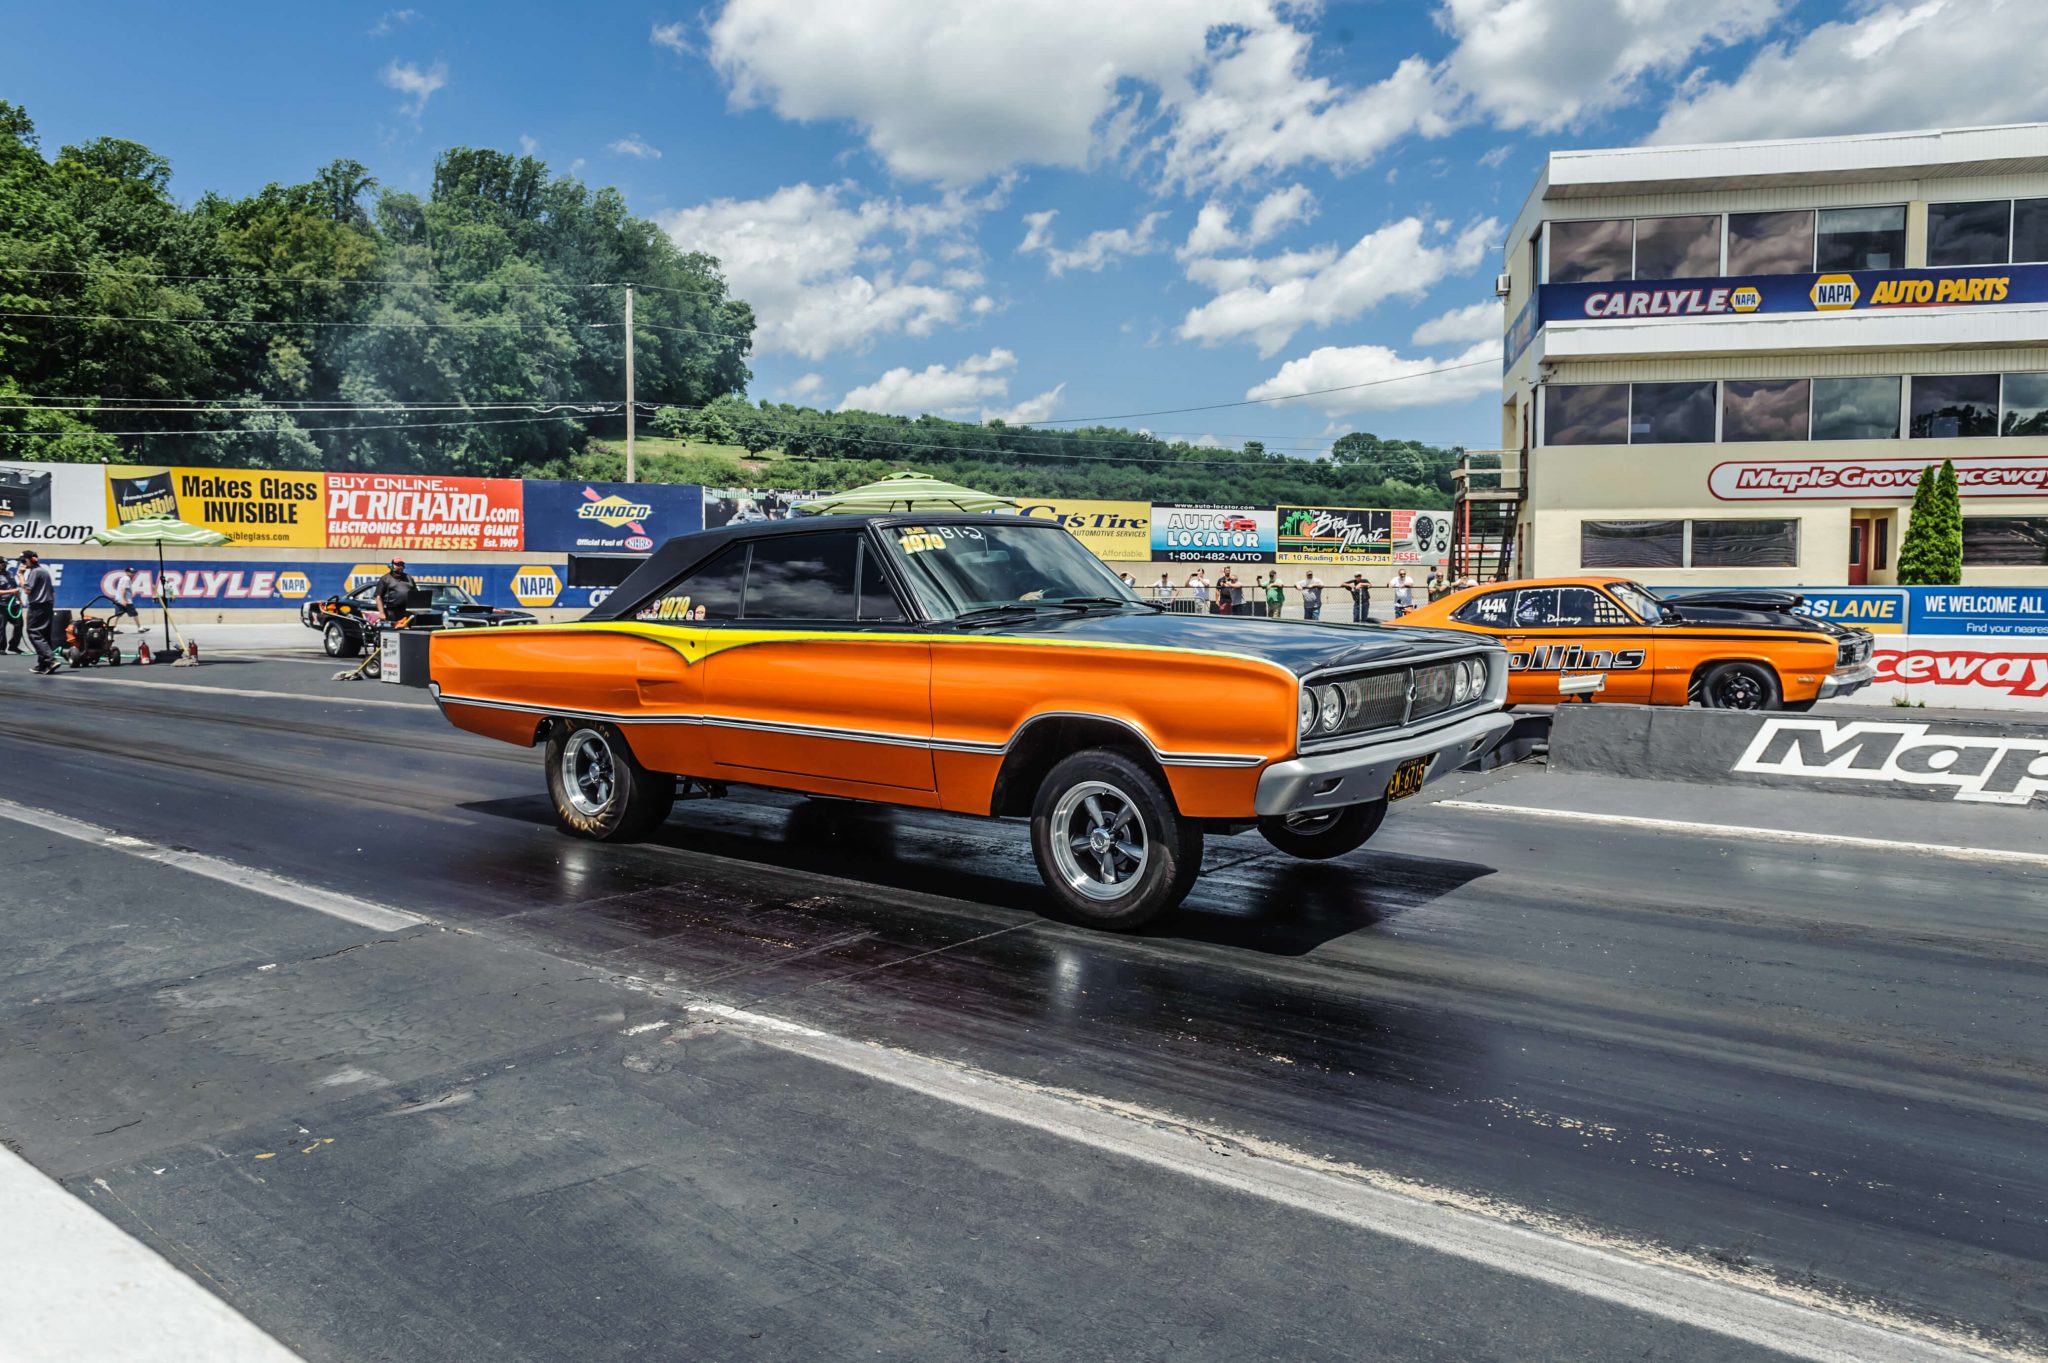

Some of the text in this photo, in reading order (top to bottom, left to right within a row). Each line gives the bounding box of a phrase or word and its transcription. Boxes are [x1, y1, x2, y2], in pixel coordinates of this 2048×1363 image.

[1735, 293, 1756, 305] NAPA
[1818, 284, 1852, 303] NAPA
[1870, 278, 2010, 304] AUTO PARTS
[1584, 288, 1730, 317] CARLYLE
[328, 476, 459, 492] BUY ONLINE...
[1736, 466, 2048, 493] Maple Grove acewa
[182, 476, 252, 499] Makes
[260, 477, 317, 501] Glass
[118, 495, 175, 520] Invisible
[204, 501, 297, 524] INVISIBLE
[581, 505, 648, 518] SUNOCO
[328, 521, 519, 536] ELECTRONICS & APPLIANCE GIANT
[1090, 513, 1148, 529] Tire
[1168, 513, 1226, 530] AUTO
[1310, 510, 1361, 538] Beer
[1116, 530, 1147, 538] SERVICES
[1167, 531, 1259, 548] LOCATOR
[1338, 528, 1390, 553] Mart
[483, 538, 519, 548] Est. 1909
[576, 537, 649, 549] Official Fuel of NHRA
[898, 534, 946, 555] 1979
[1168, 552, 1262, 561] 1-800-482-AUTO
[1304, 554, 1333, 562] Reading
[1393, 552, 1419, 560] JESEL
[101, 569, 276, 599] CARLYLE
[282, 578, 306, 591] NAPA
[519, 576, 555, 595] NAPA
[1477, 598, 1508, 613] 144K
[1925, 595, 2045, 614] WE WELCOME ALL
[1546, 613, 1582, 625] Danny
[1966, 622, 1987, 633] Find
[1989, 625, 2012, 634] your
